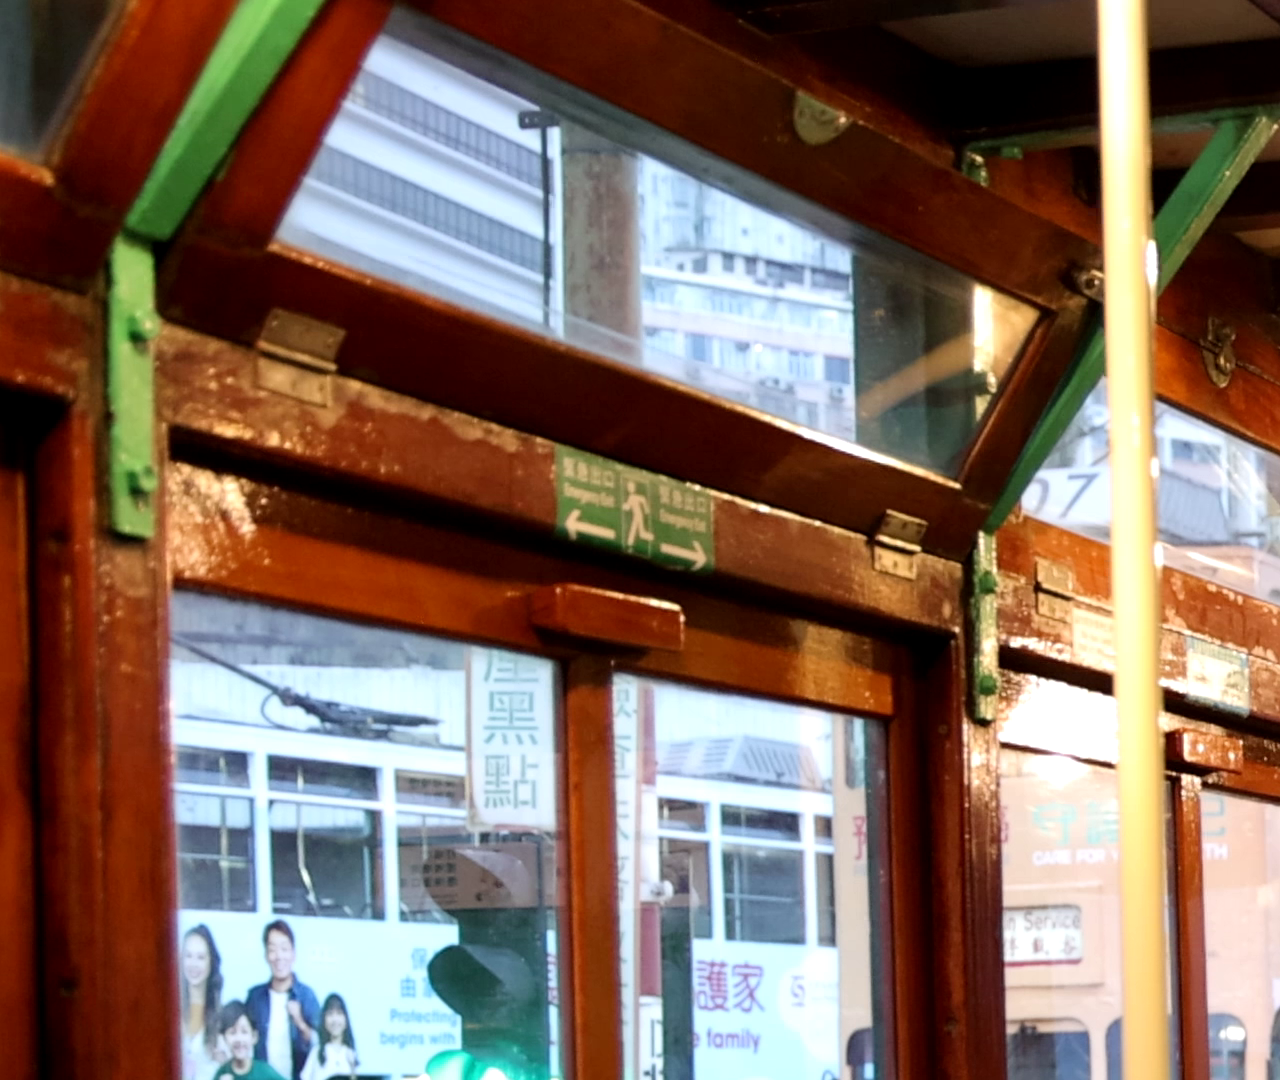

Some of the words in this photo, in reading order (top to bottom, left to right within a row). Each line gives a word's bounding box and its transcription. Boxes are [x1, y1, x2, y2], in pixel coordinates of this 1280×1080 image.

[1024, 911, 1081, 931] Service
[390, 1008, 458, 1026] Protecting
[380, 1031, 424, 1049] begins
[429, 1031, 456, 1045] with
[707, 1028, 761, 1054] family
